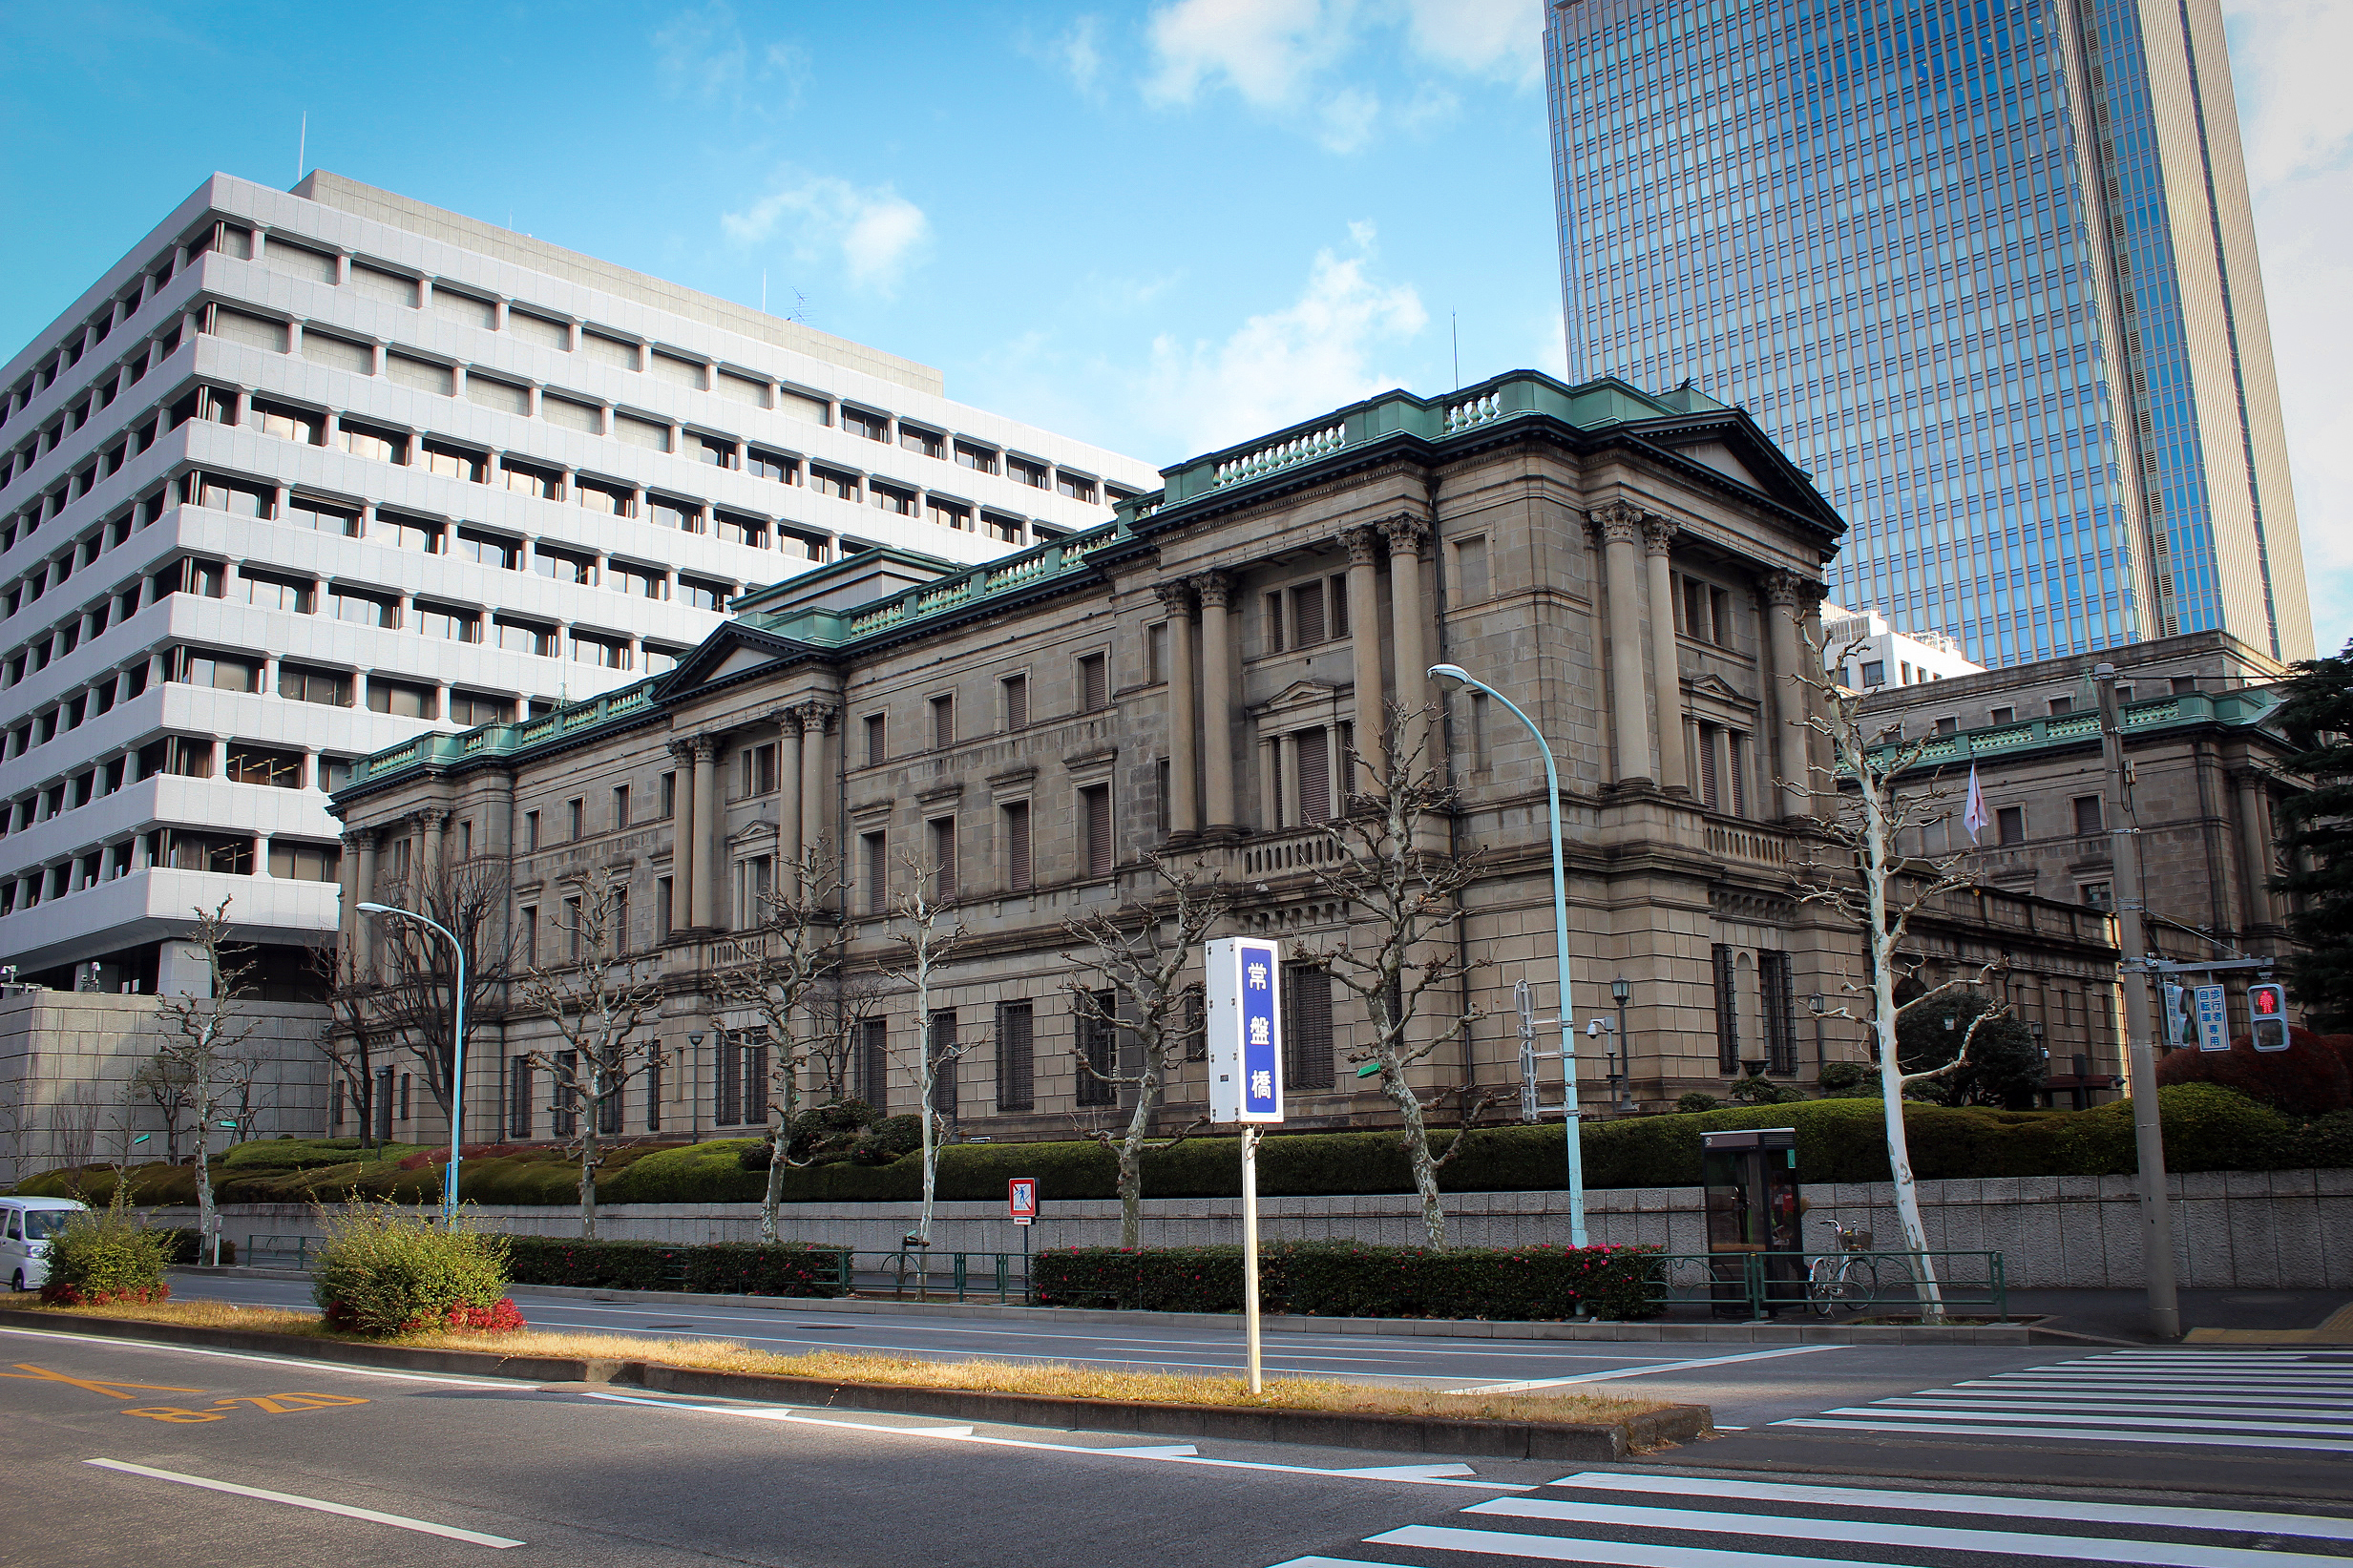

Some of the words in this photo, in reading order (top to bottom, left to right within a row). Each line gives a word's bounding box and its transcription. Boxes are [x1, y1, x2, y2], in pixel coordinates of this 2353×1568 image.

[2199, 991, 2212, 1022] 自転車
[2210, 990, 2222, 1022] 歩行者
[1248, 962, 1271, 1099] 常盤橋
[2208, 1024, 2220, 1047] 専用
[120, 1392, 370, 1423] 8-20
